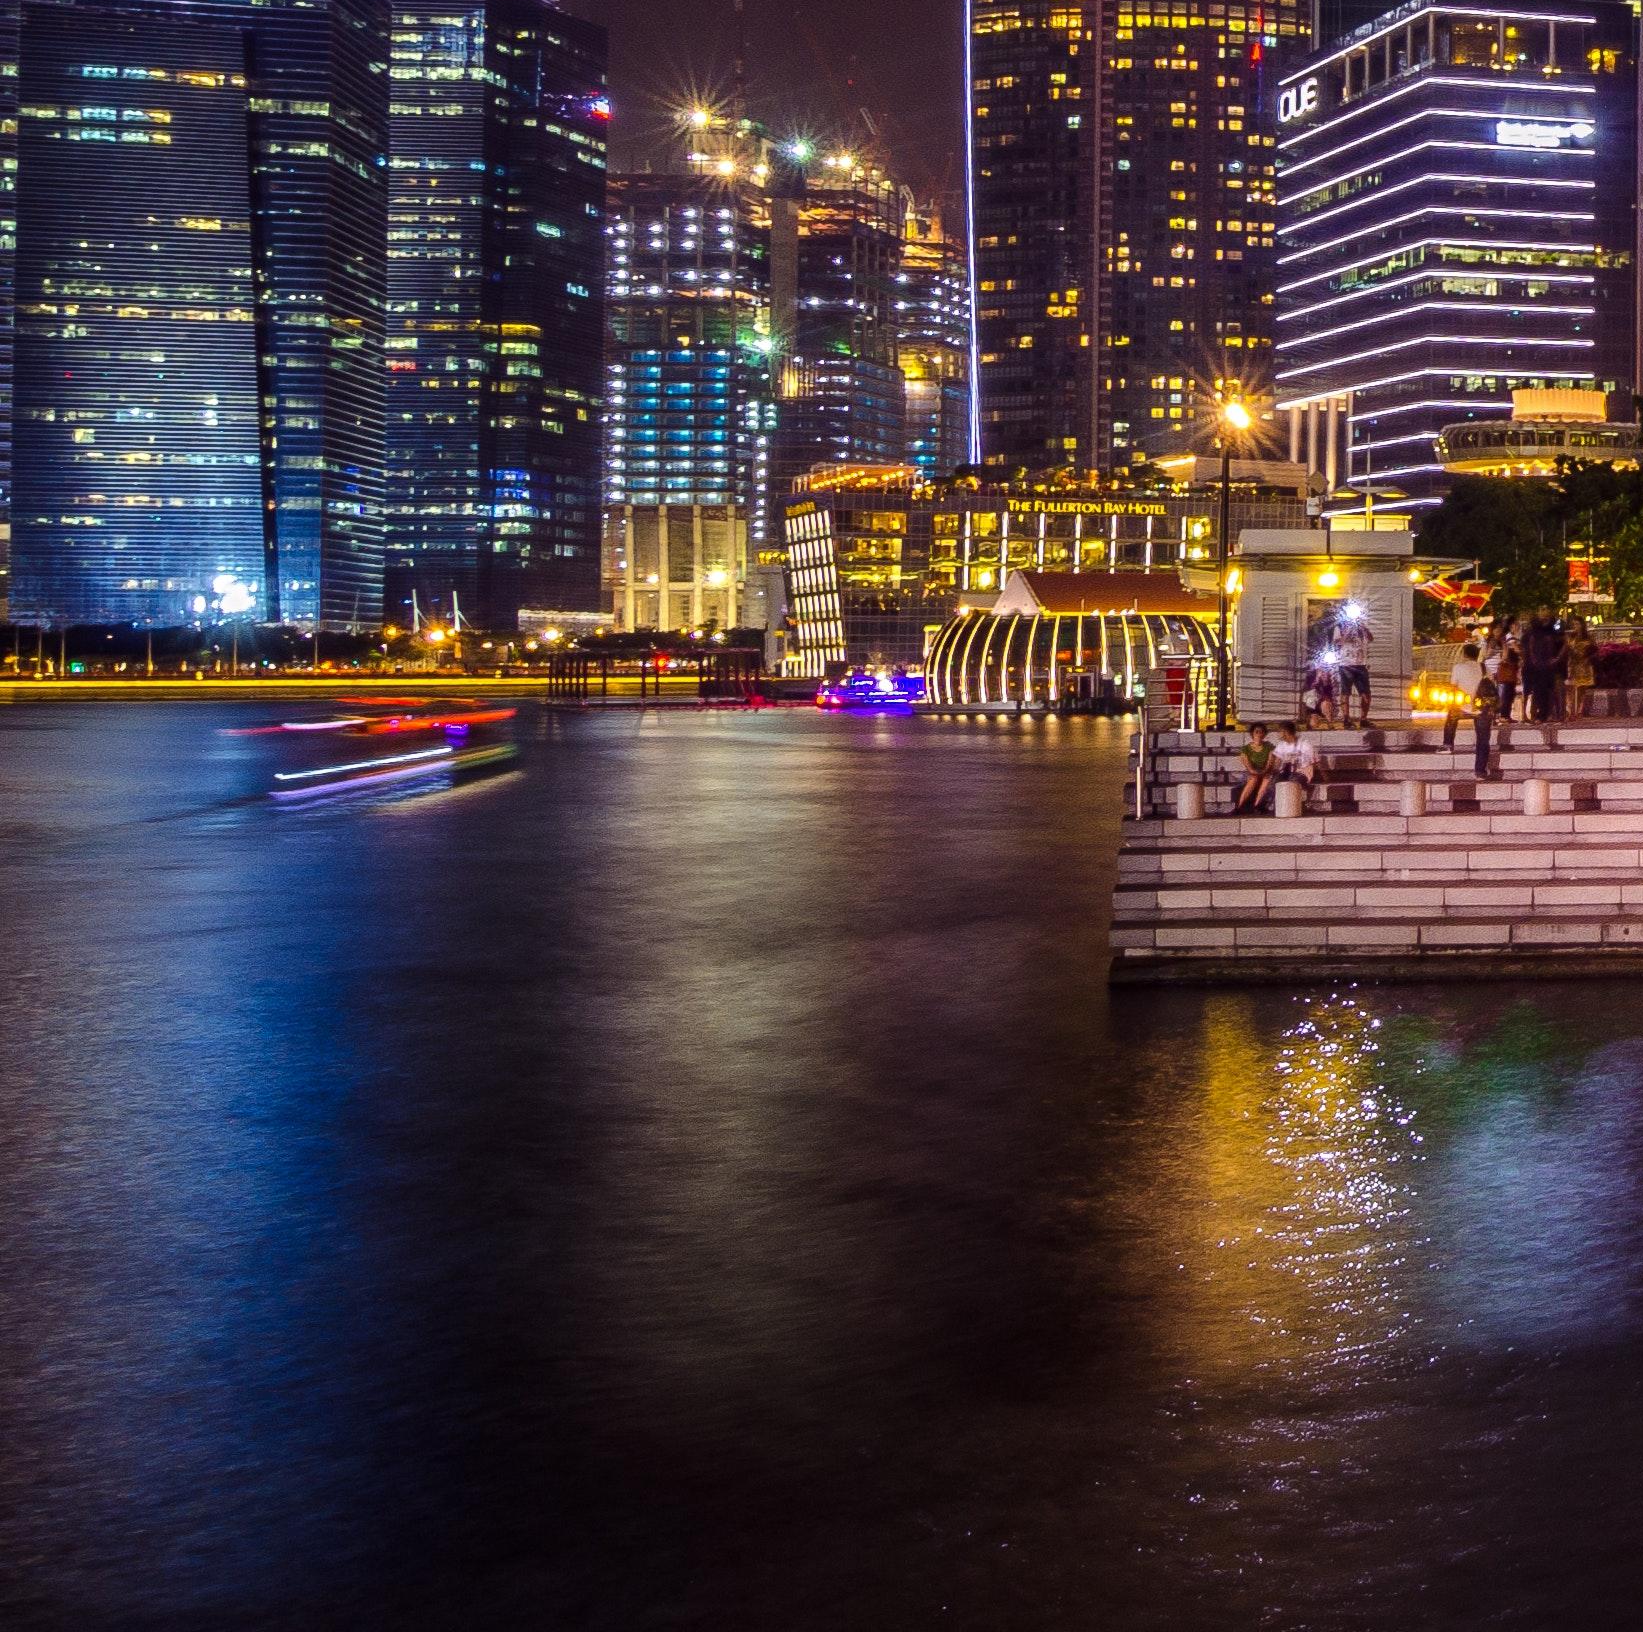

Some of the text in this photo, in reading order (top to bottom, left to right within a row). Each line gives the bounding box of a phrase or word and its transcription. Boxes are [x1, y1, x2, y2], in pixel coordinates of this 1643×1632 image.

[1008, 499, 1167, 515] THE FULLERTON BAY HOTEL
